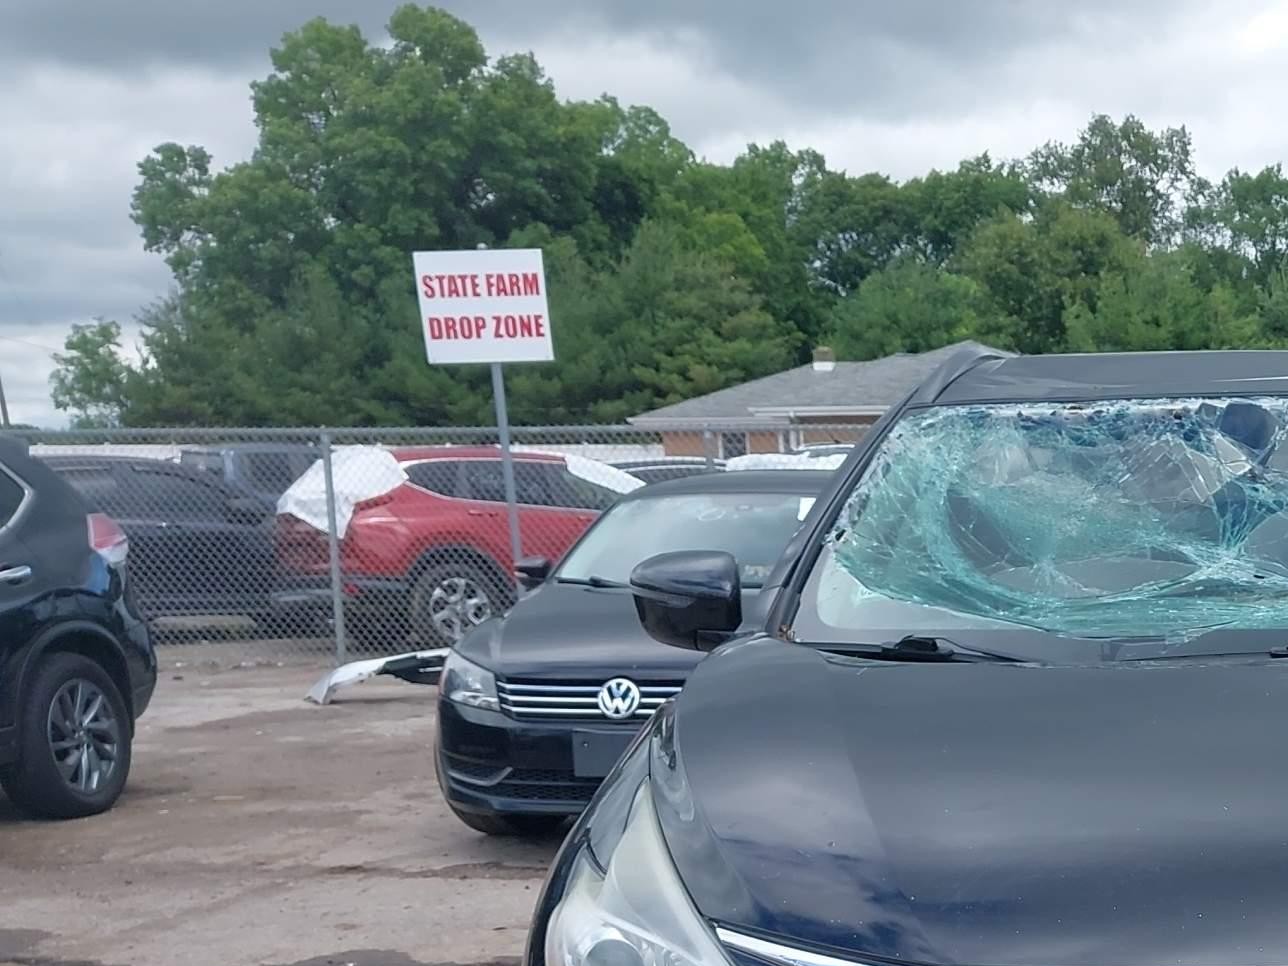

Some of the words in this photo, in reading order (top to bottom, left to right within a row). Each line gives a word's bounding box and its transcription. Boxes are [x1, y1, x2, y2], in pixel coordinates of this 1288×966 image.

[422, 274, 481, 299] STATE
[485, 272, 540, 297] FARM
[428, 315, 487, 340] DROP
[492, 314, 545, 339] ZONE
